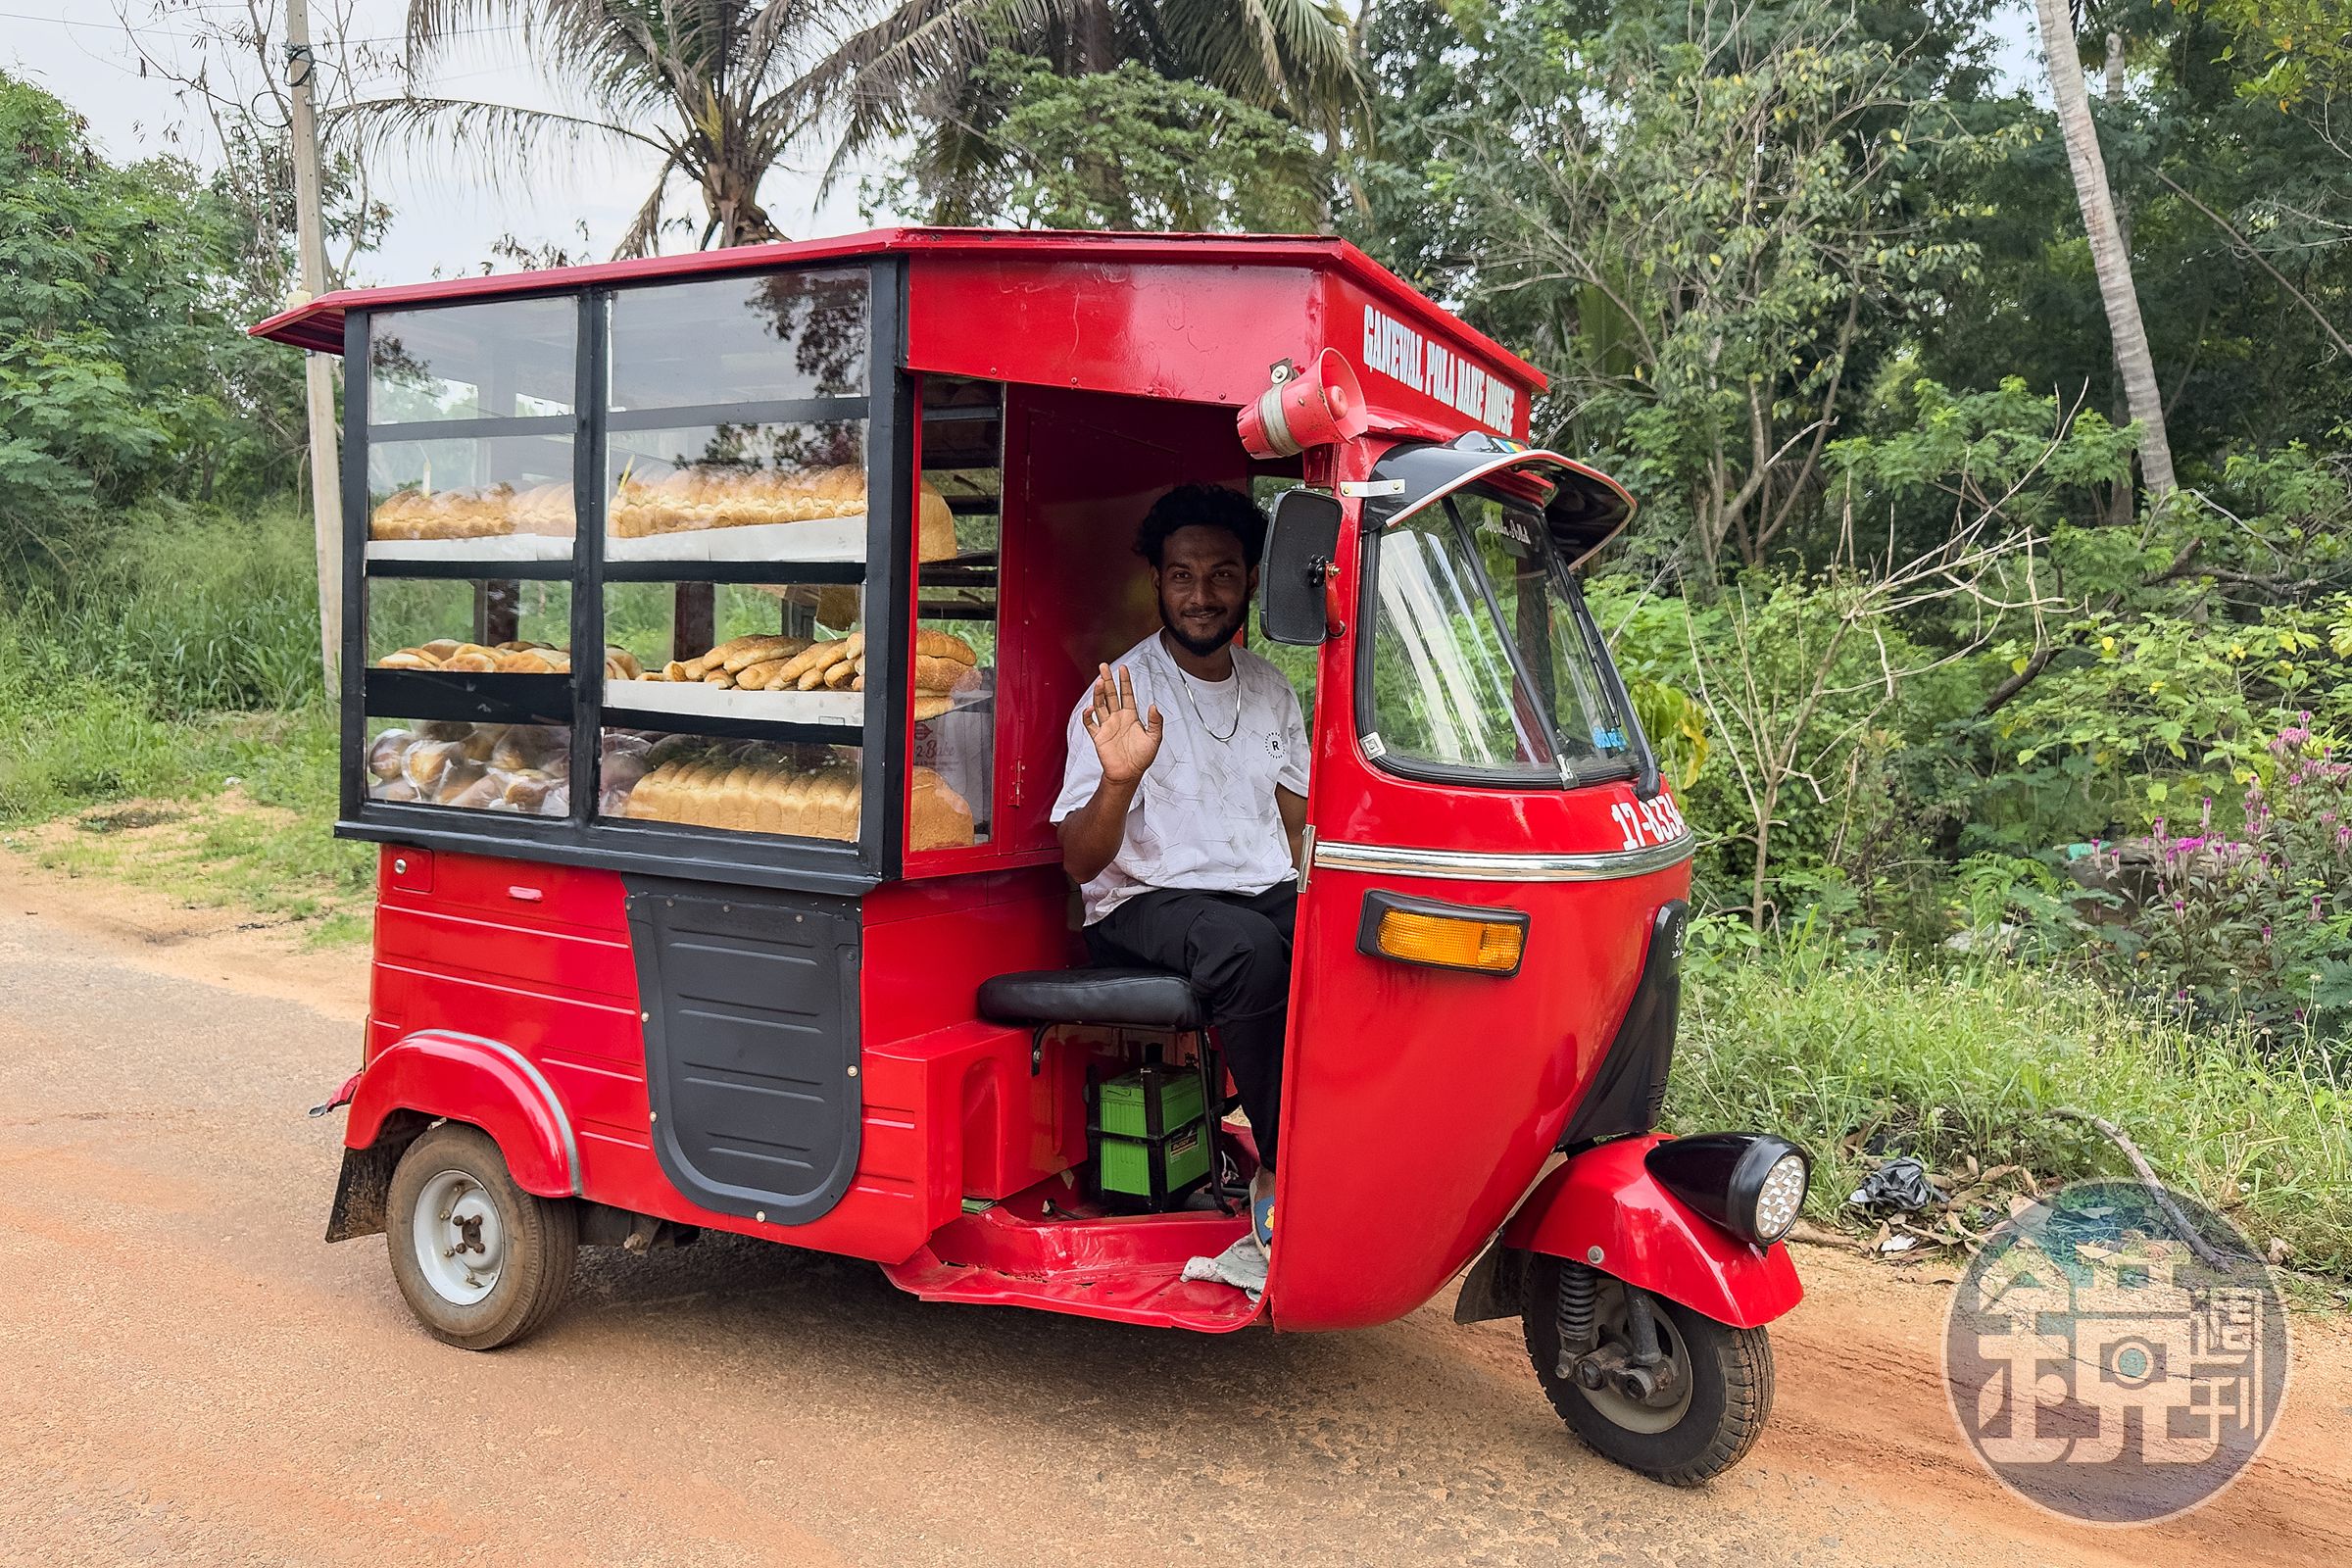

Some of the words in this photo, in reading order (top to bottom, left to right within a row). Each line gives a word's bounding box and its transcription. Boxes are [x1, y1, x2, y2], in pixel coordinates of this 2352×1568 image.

[1425, 340, 1455, 408] POLA
[1455, 358, 1486, 422] BAKE
[1483, 373, 1516, 437] HOUSE
[1272, 740, 1280, 751] R
